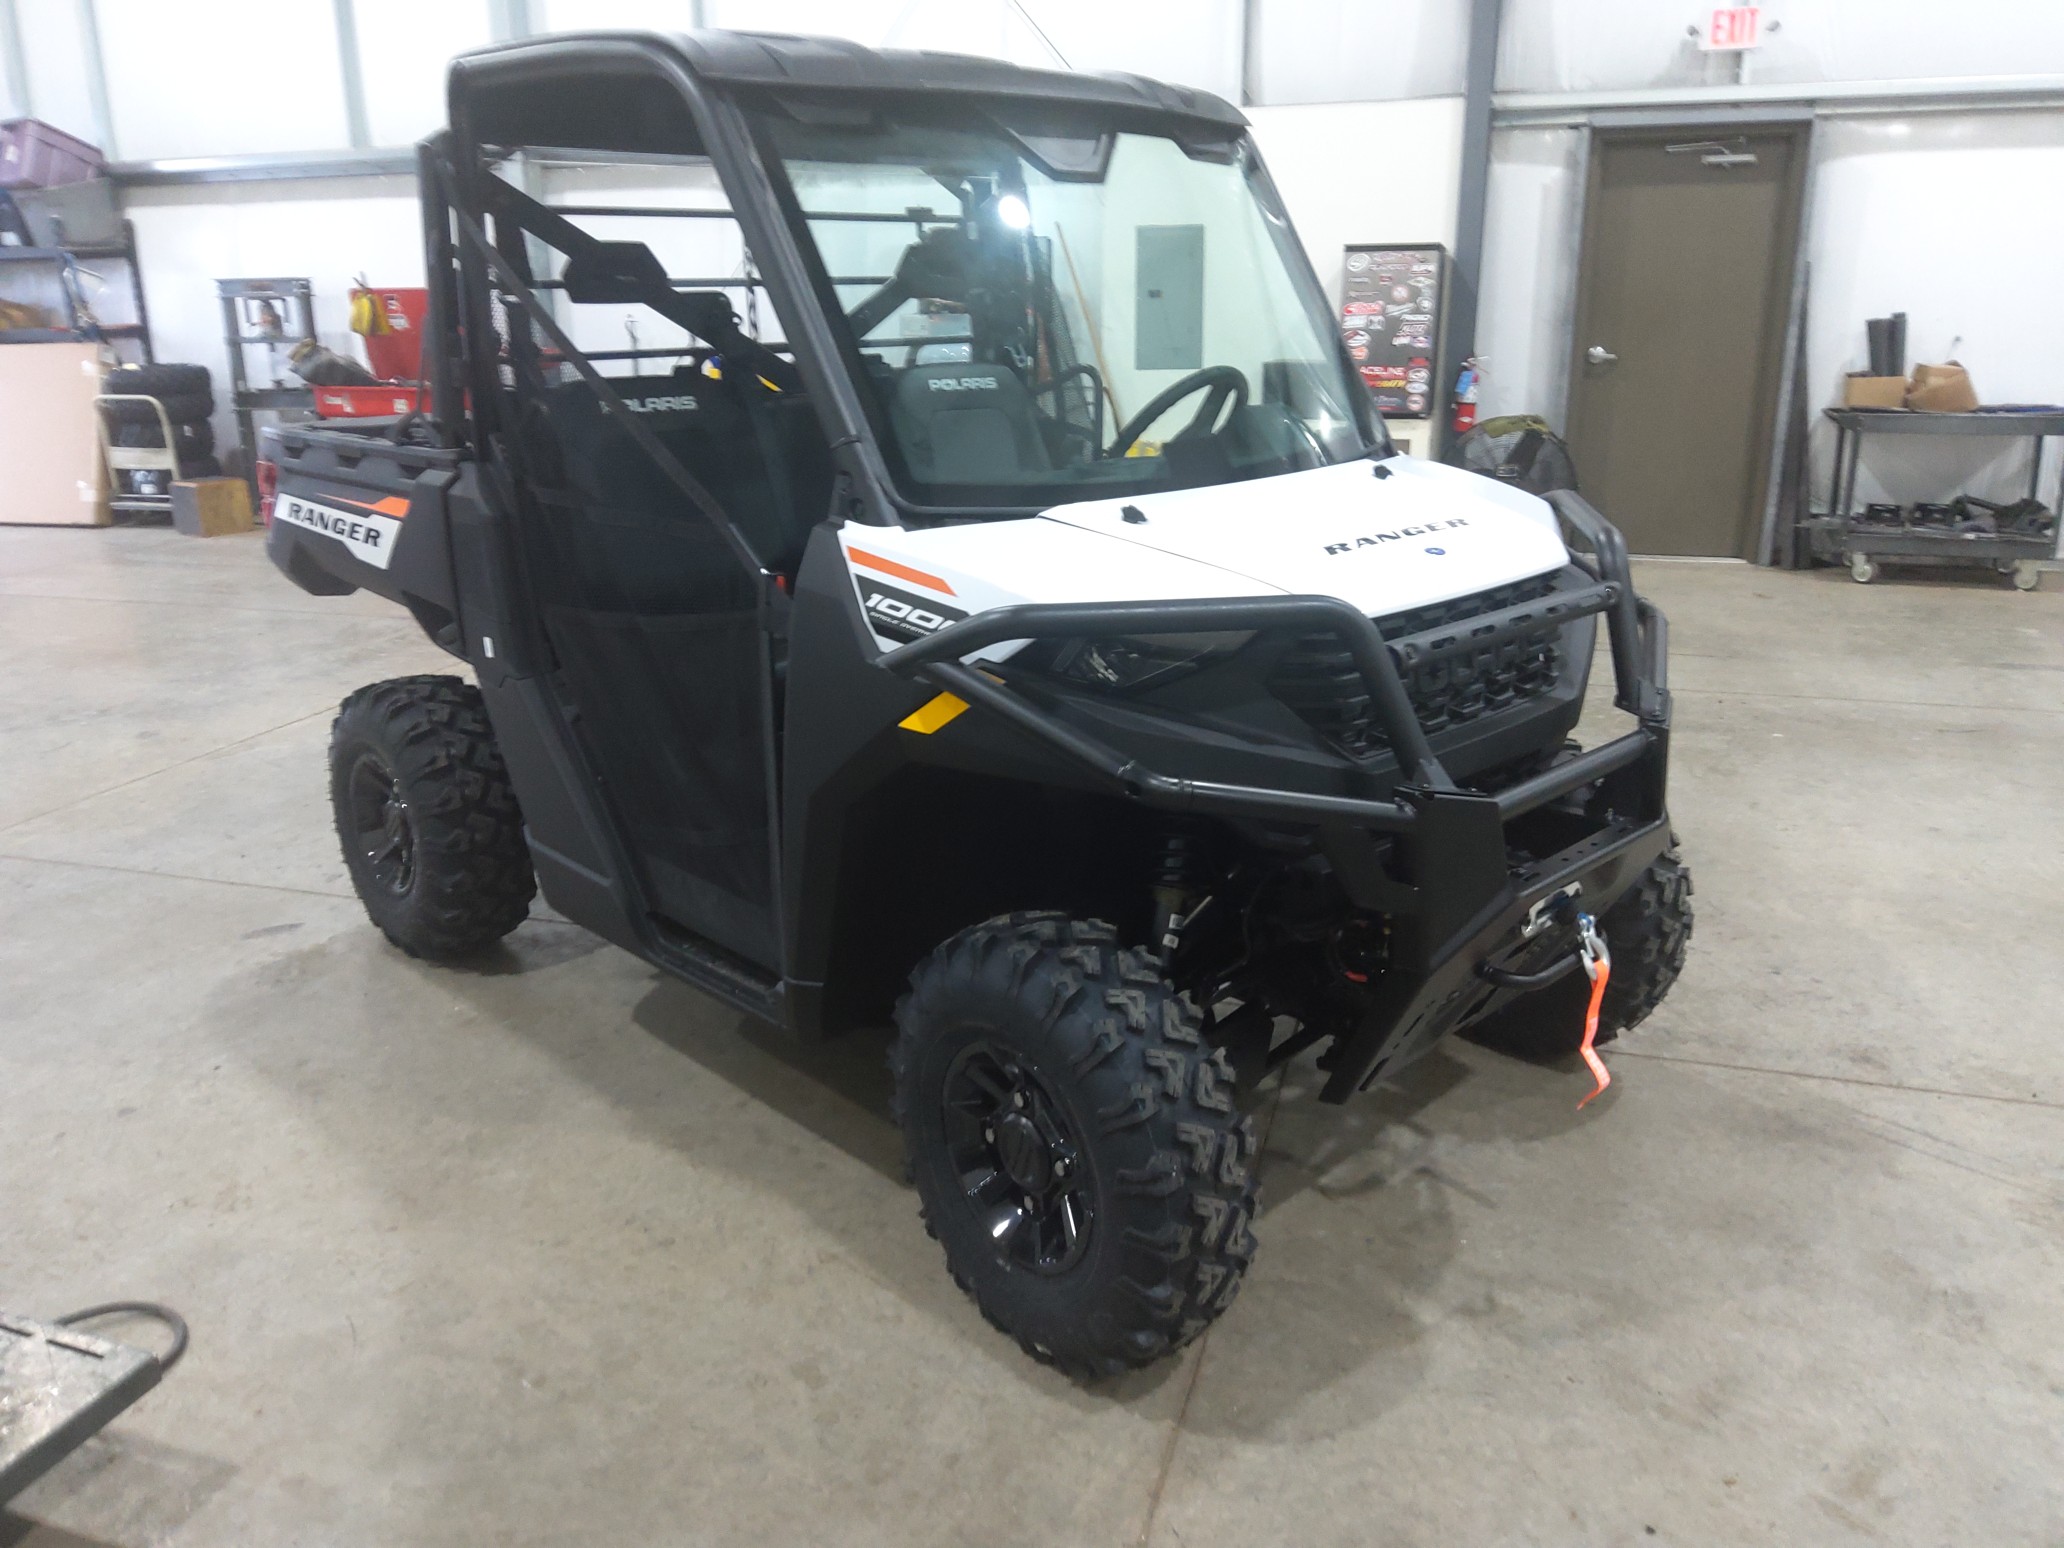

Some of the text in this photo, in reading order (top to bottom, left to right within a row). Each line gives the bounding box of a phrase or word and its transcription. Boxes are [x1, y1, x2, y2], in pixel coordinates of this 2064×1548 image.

[1711, 8, 1760, 45] EXIT
[928, 377, 999, 391] POLARIS
[1360, 366, 1406, 375] ACELINE
[288, 502, 381, 548] RANGER
[1323, 518, 1470, 556] RANGER
